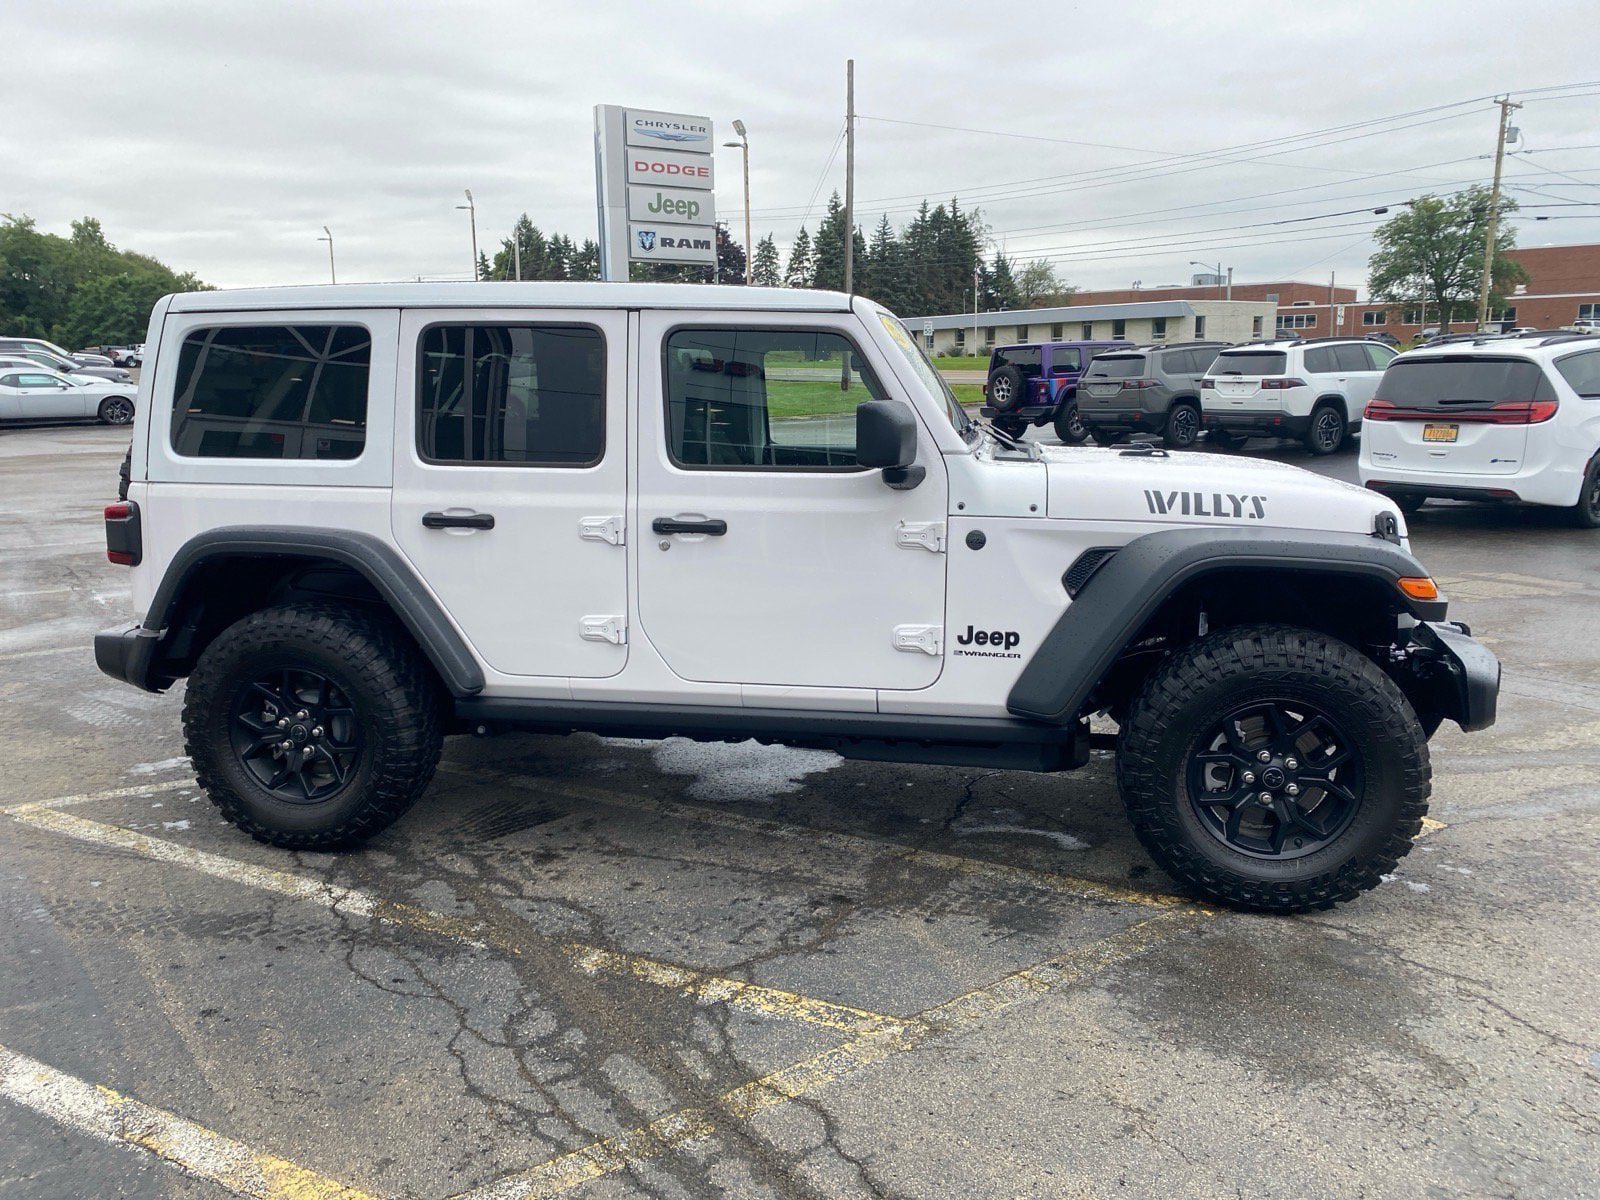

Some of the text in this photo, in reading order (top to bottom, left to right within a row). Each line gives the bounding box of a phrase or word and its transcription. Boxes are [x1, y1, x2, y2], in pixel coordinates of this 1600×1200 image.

[635, 119, 707, 133] CHRYSLER
[634, 161, 710, 178] DODGE
[648, 192, 700, 220] Jeep
[660, 237, 711, 250] RAM
[1143, 489, 1268, 519] WILLYS
[957, 625, 1020, 650] Jeep
[963, 650, 1022, 659] WRANGLER
